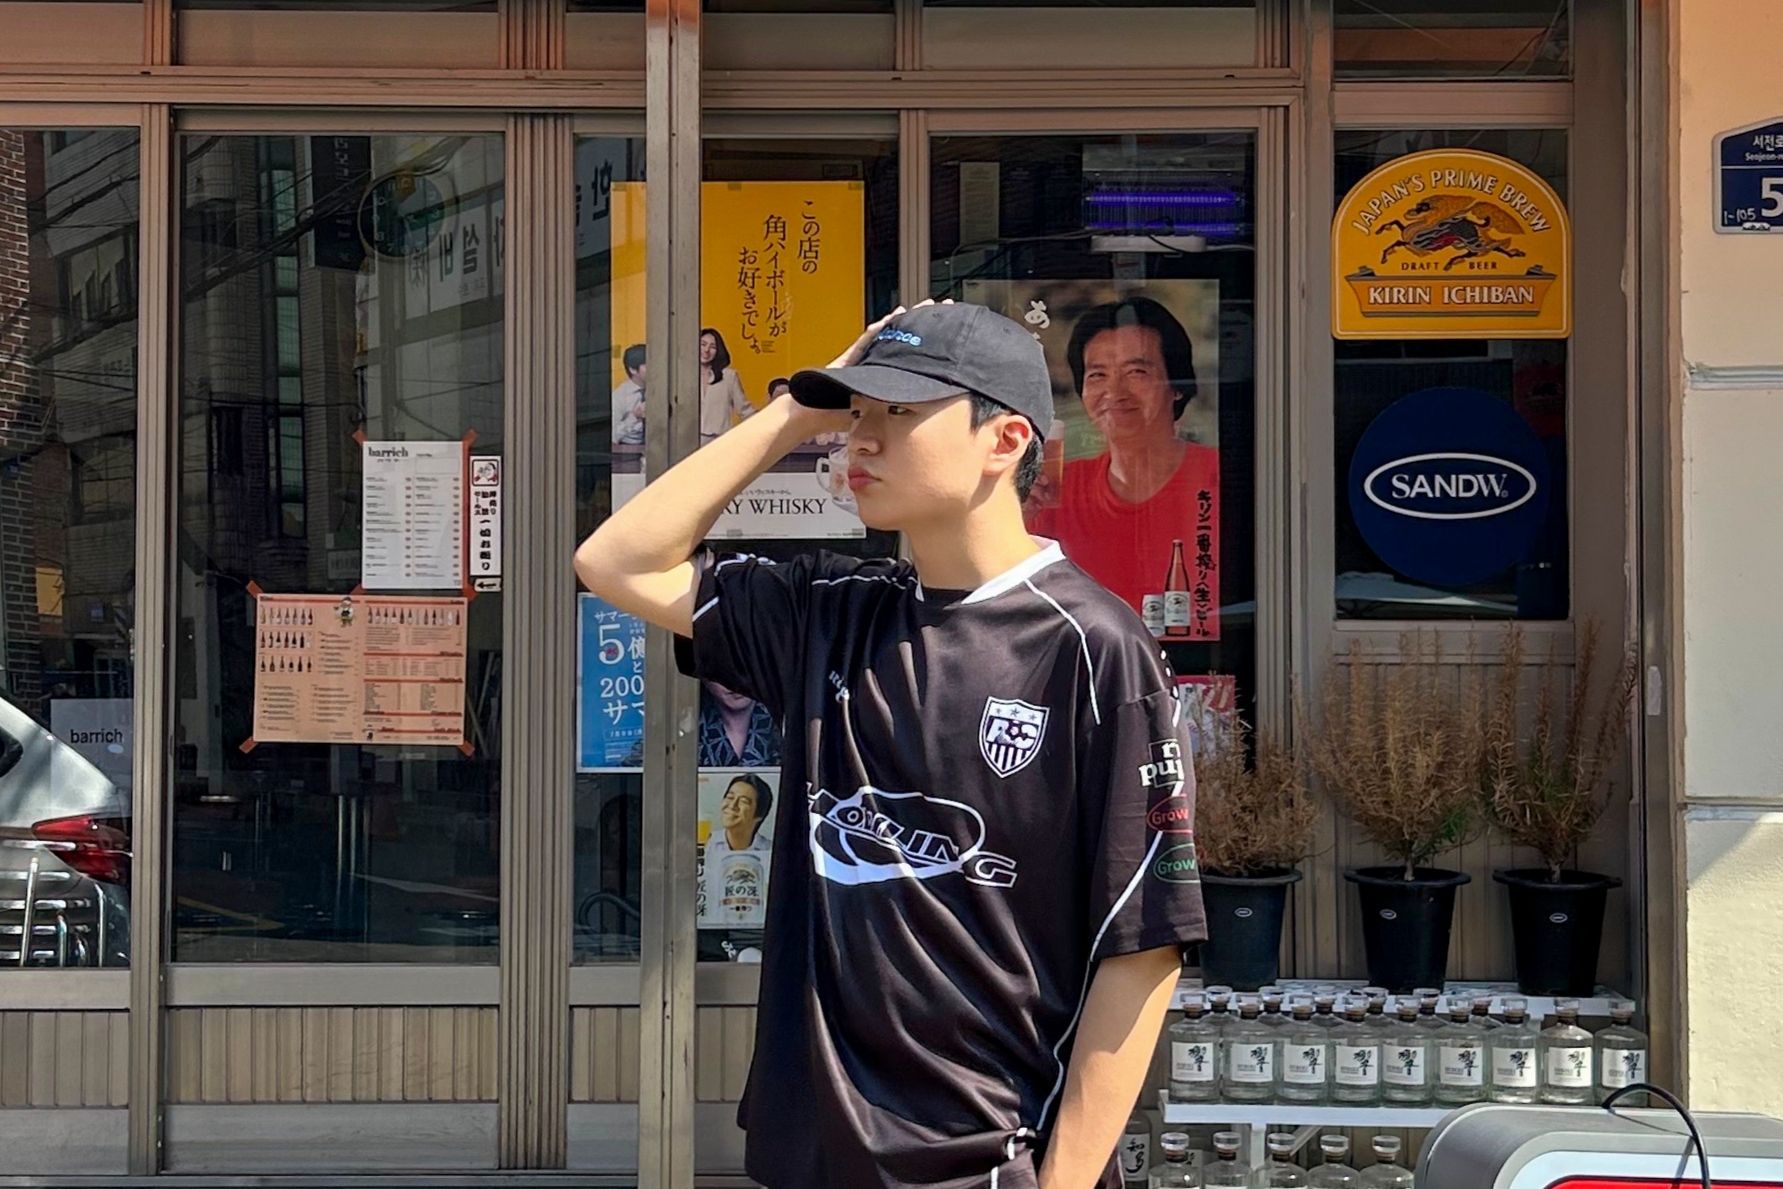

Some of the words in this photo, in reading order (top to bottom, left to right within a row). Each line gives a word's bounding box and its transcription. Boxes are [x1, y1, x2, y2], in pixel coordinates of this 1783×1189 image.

[1352, 173, 1425, 236] JAPAN'S
[1431, 169, 1499, 195] PRIME
[1499, 184, 1551, 234] BREW
[797, 200, 821, 275] この店の
[1401, 261, 1439, 271] DRAFT
[1468, 261, 1498, 271] BEER
[763, 214, 787, 338] 角ハイボールが
[1368, 286, 1431, 305] KIRIN
[1443, 286, 1534, 305] ICHIBAN
[368, 446, 409, 457] barrich
[749, 498, 827, 515] WHISKY
[70, 727, 124, 744] barrich
